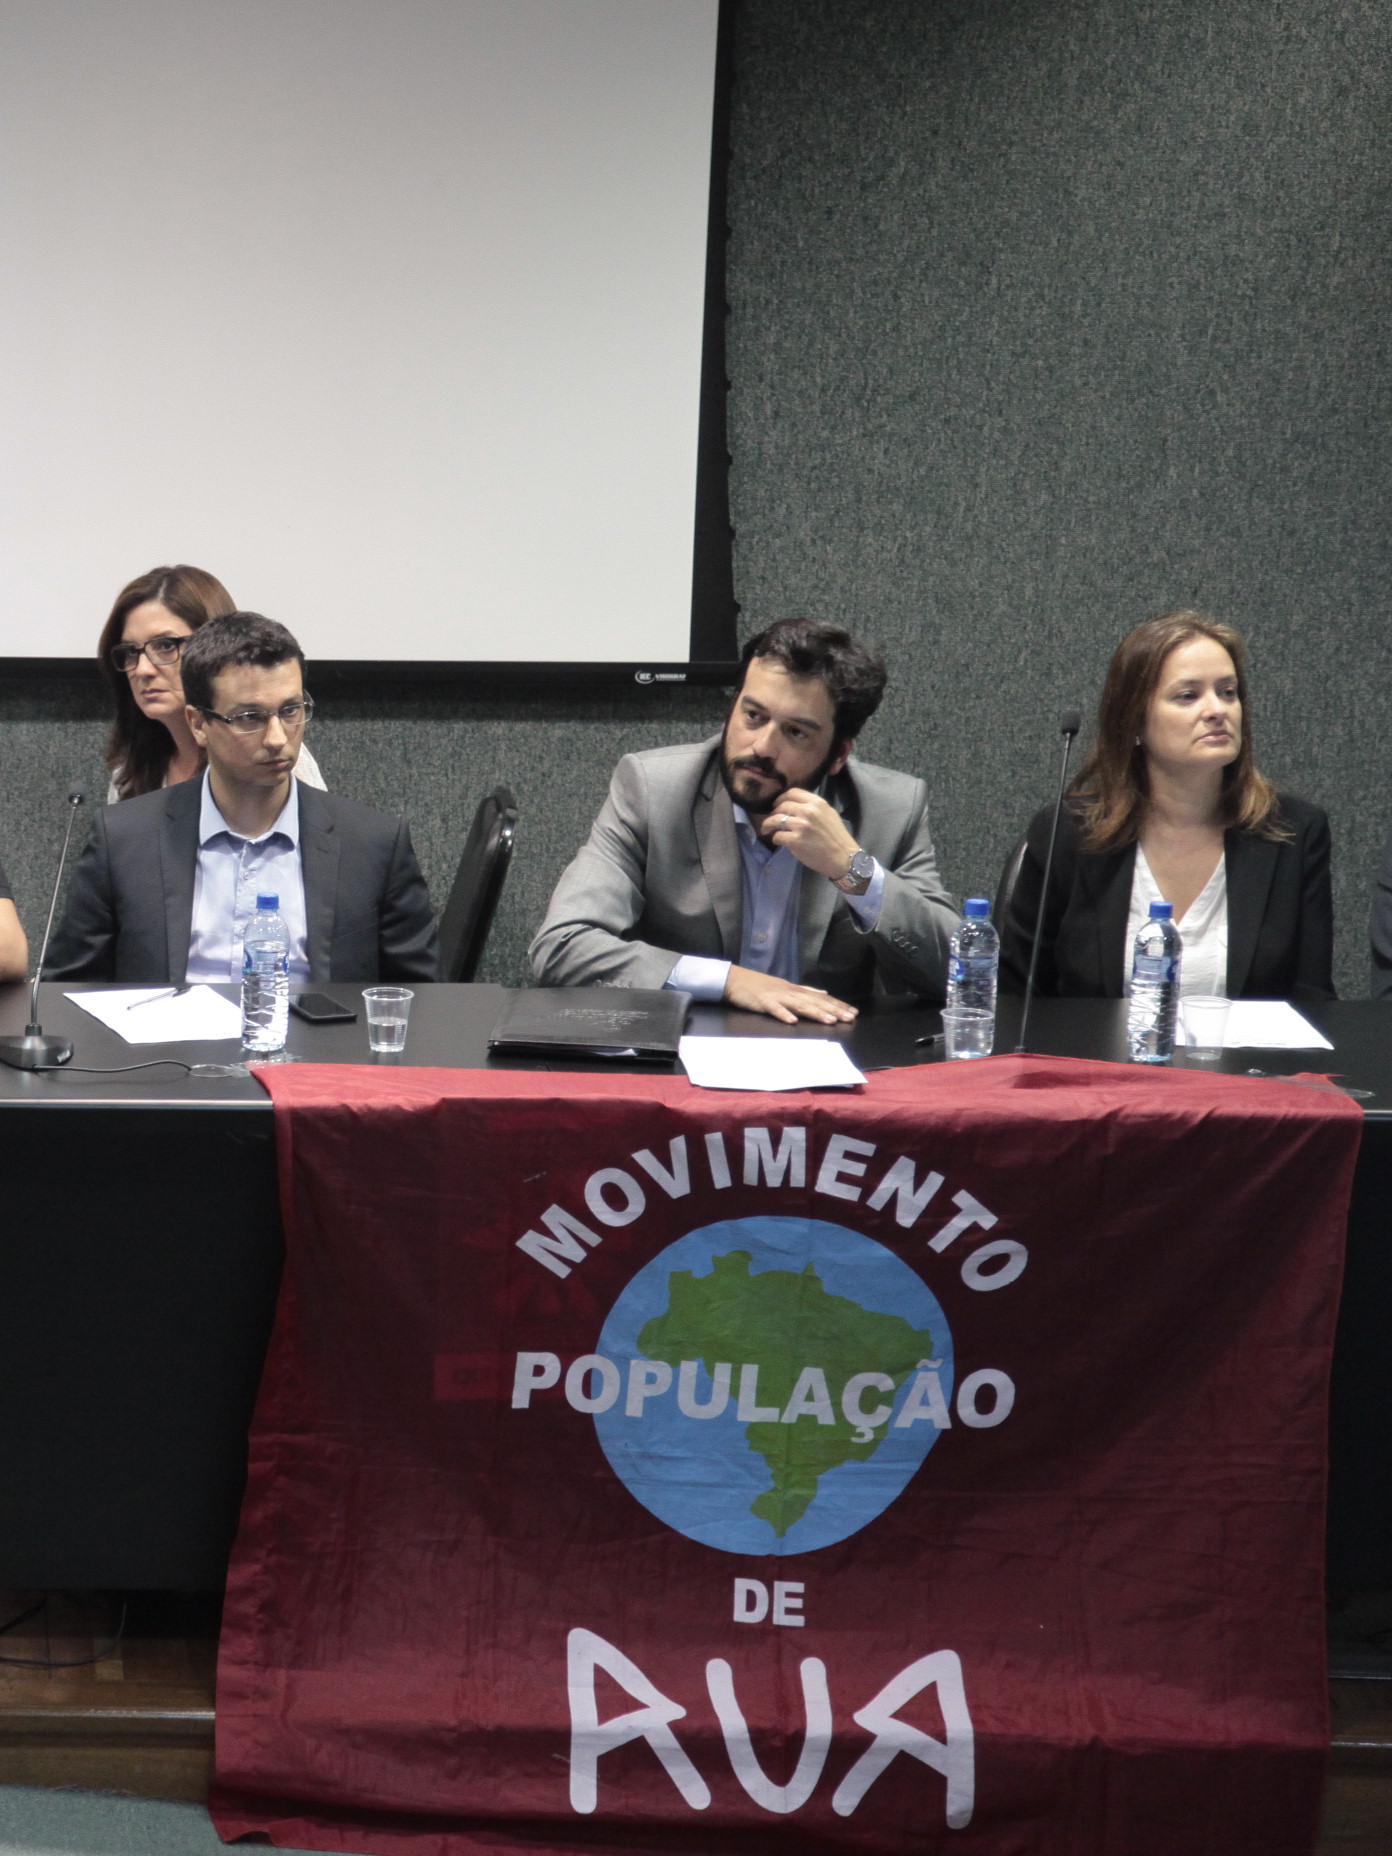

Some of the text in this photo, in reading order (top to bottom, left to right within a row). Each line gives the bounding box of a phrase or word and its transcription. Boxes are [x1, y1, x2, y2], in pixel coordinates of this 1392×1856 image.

[515, 1126, 1029, 1292] MOVIMENTO
[511, 1351, 1016, 1443] POPULAÇÃO
[733, 1578, 805, 1627] DE
[567, 1628, 975, 1829] RUA
